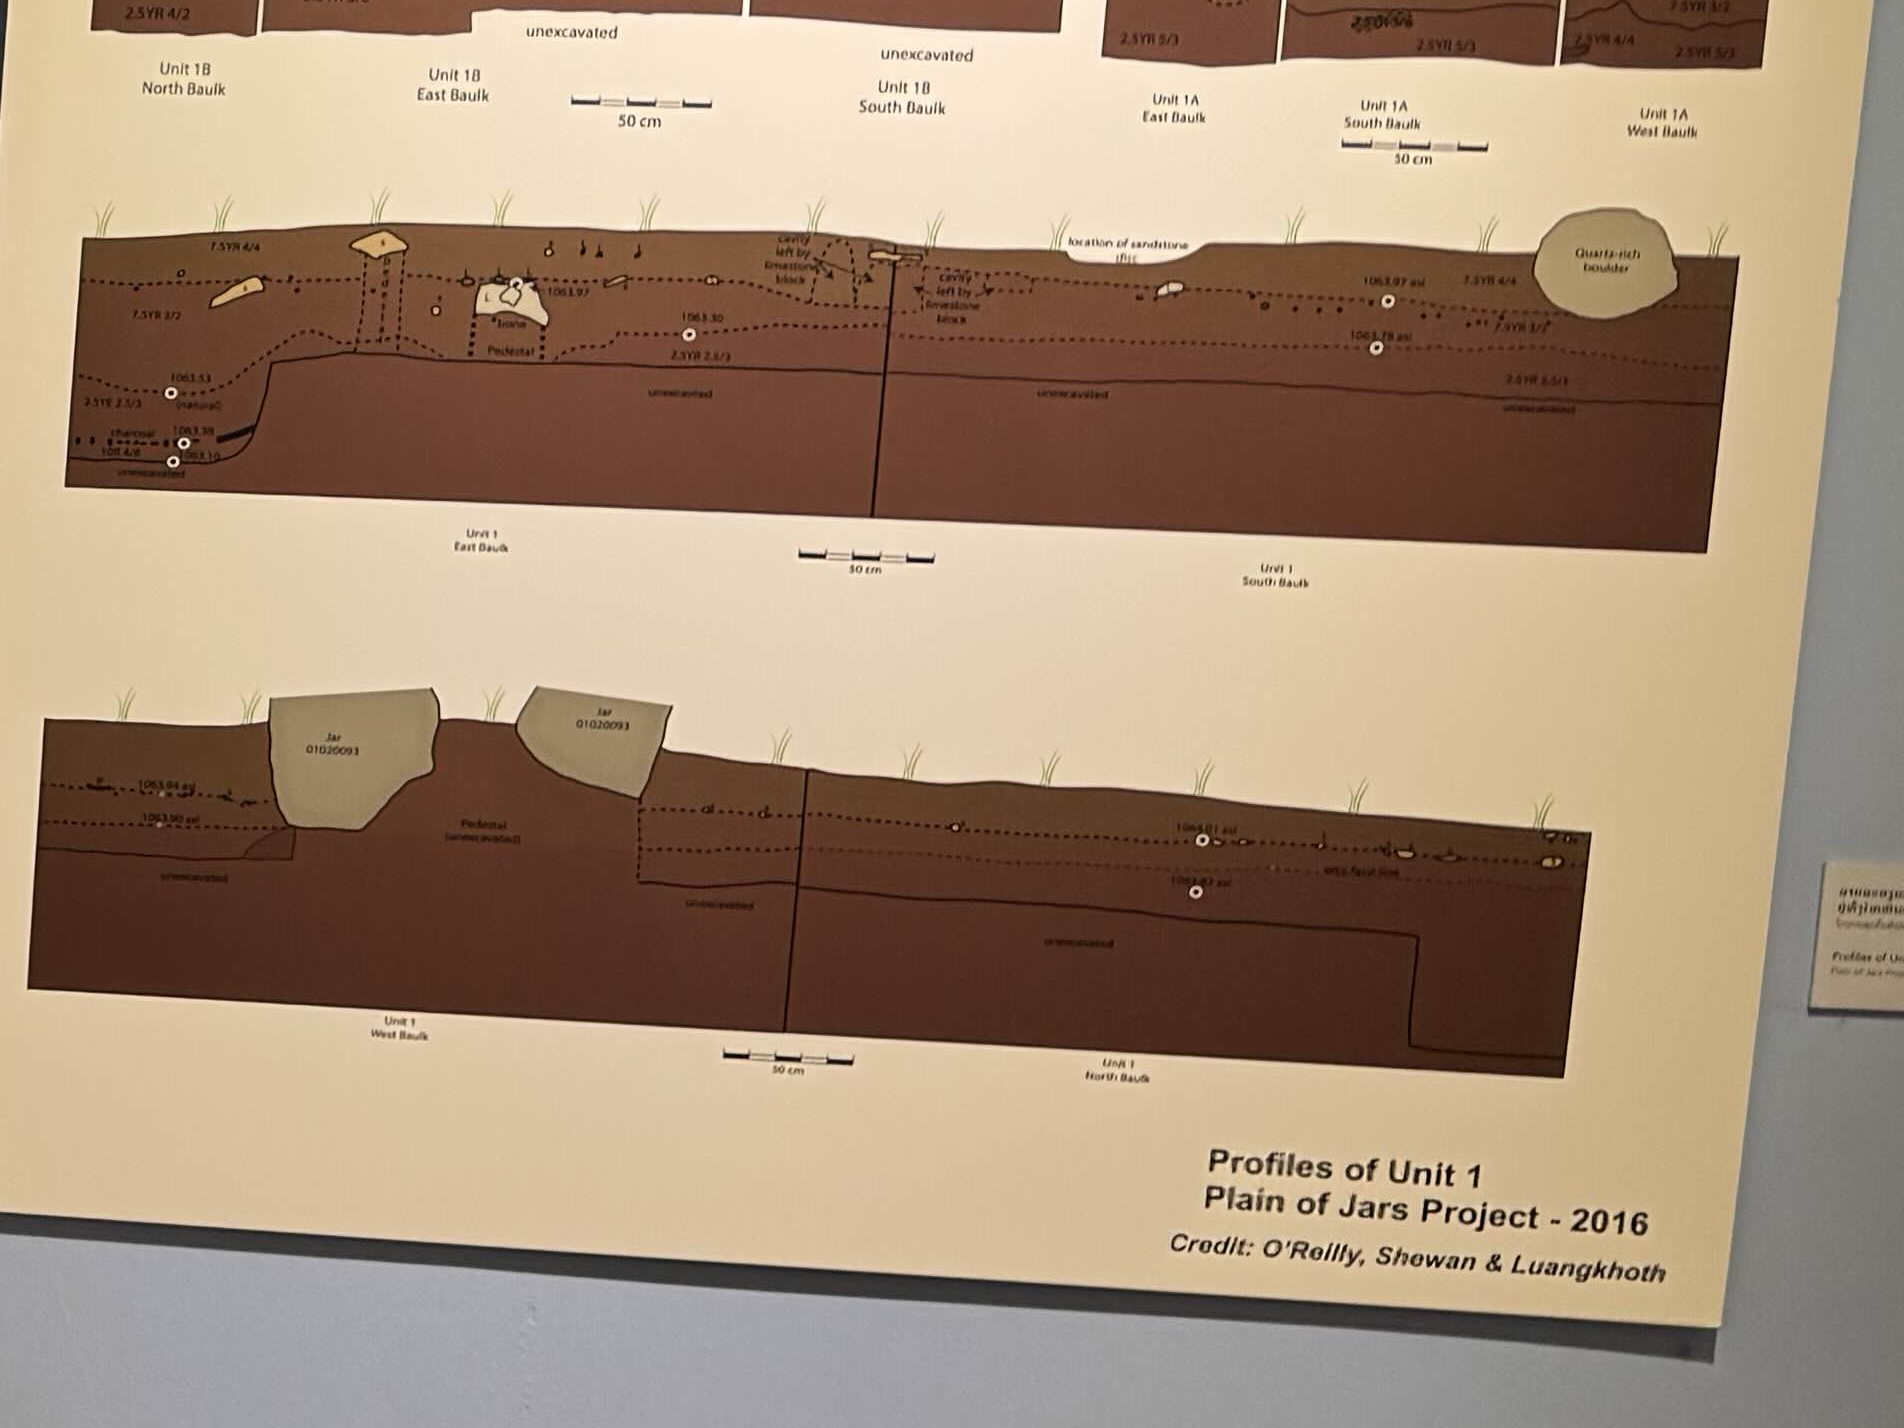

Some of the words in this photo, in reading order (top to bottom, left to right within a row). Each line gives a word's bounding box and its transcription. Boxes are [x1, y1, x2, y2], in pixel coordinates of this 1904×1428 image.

[527, 26, 617, 39] unexcavated
[881, 49, 973, 62] unexcavated
[160, 62, 189, 75] Unit
[195, 63, 211, 76] 1B
[429, 68, 458, 81] Unit
[143, 82, 183, 94] North
[187, 82, 225, 95] Baulk
[879, 80, 907, 94] Unit
[418, 88, 445, 101] East
[451, 89, 488, 101] Baulk
[859, 100, 901, 113] South
[1640, 108, 1667, 120] Unit
[619, 115, 636, 127] 50
[640, 118, 661, 127] cm
[1209, 1149, 1332, 1179] Profiles
[1346, 1158, 1379, 1181] of
[1389, 1160, 1455, 1187] Unit
[1468, 1164, 1480, 1188] 1
[1205, 1186, 1284, 1212] Plain
[1297, 1192, 1331, 1215] of
[1339, 1194, 1408, 1221] Jars
[1422, 1199, 1538, 1232] Project
[1571, 1209, 1648, 1236] 2016
[1171, 1234, 1254, 1256] Credit:
[1486, 1254, 1502, 1272] &
[1512, 1255, 1666, 1283] Luangkhoth
